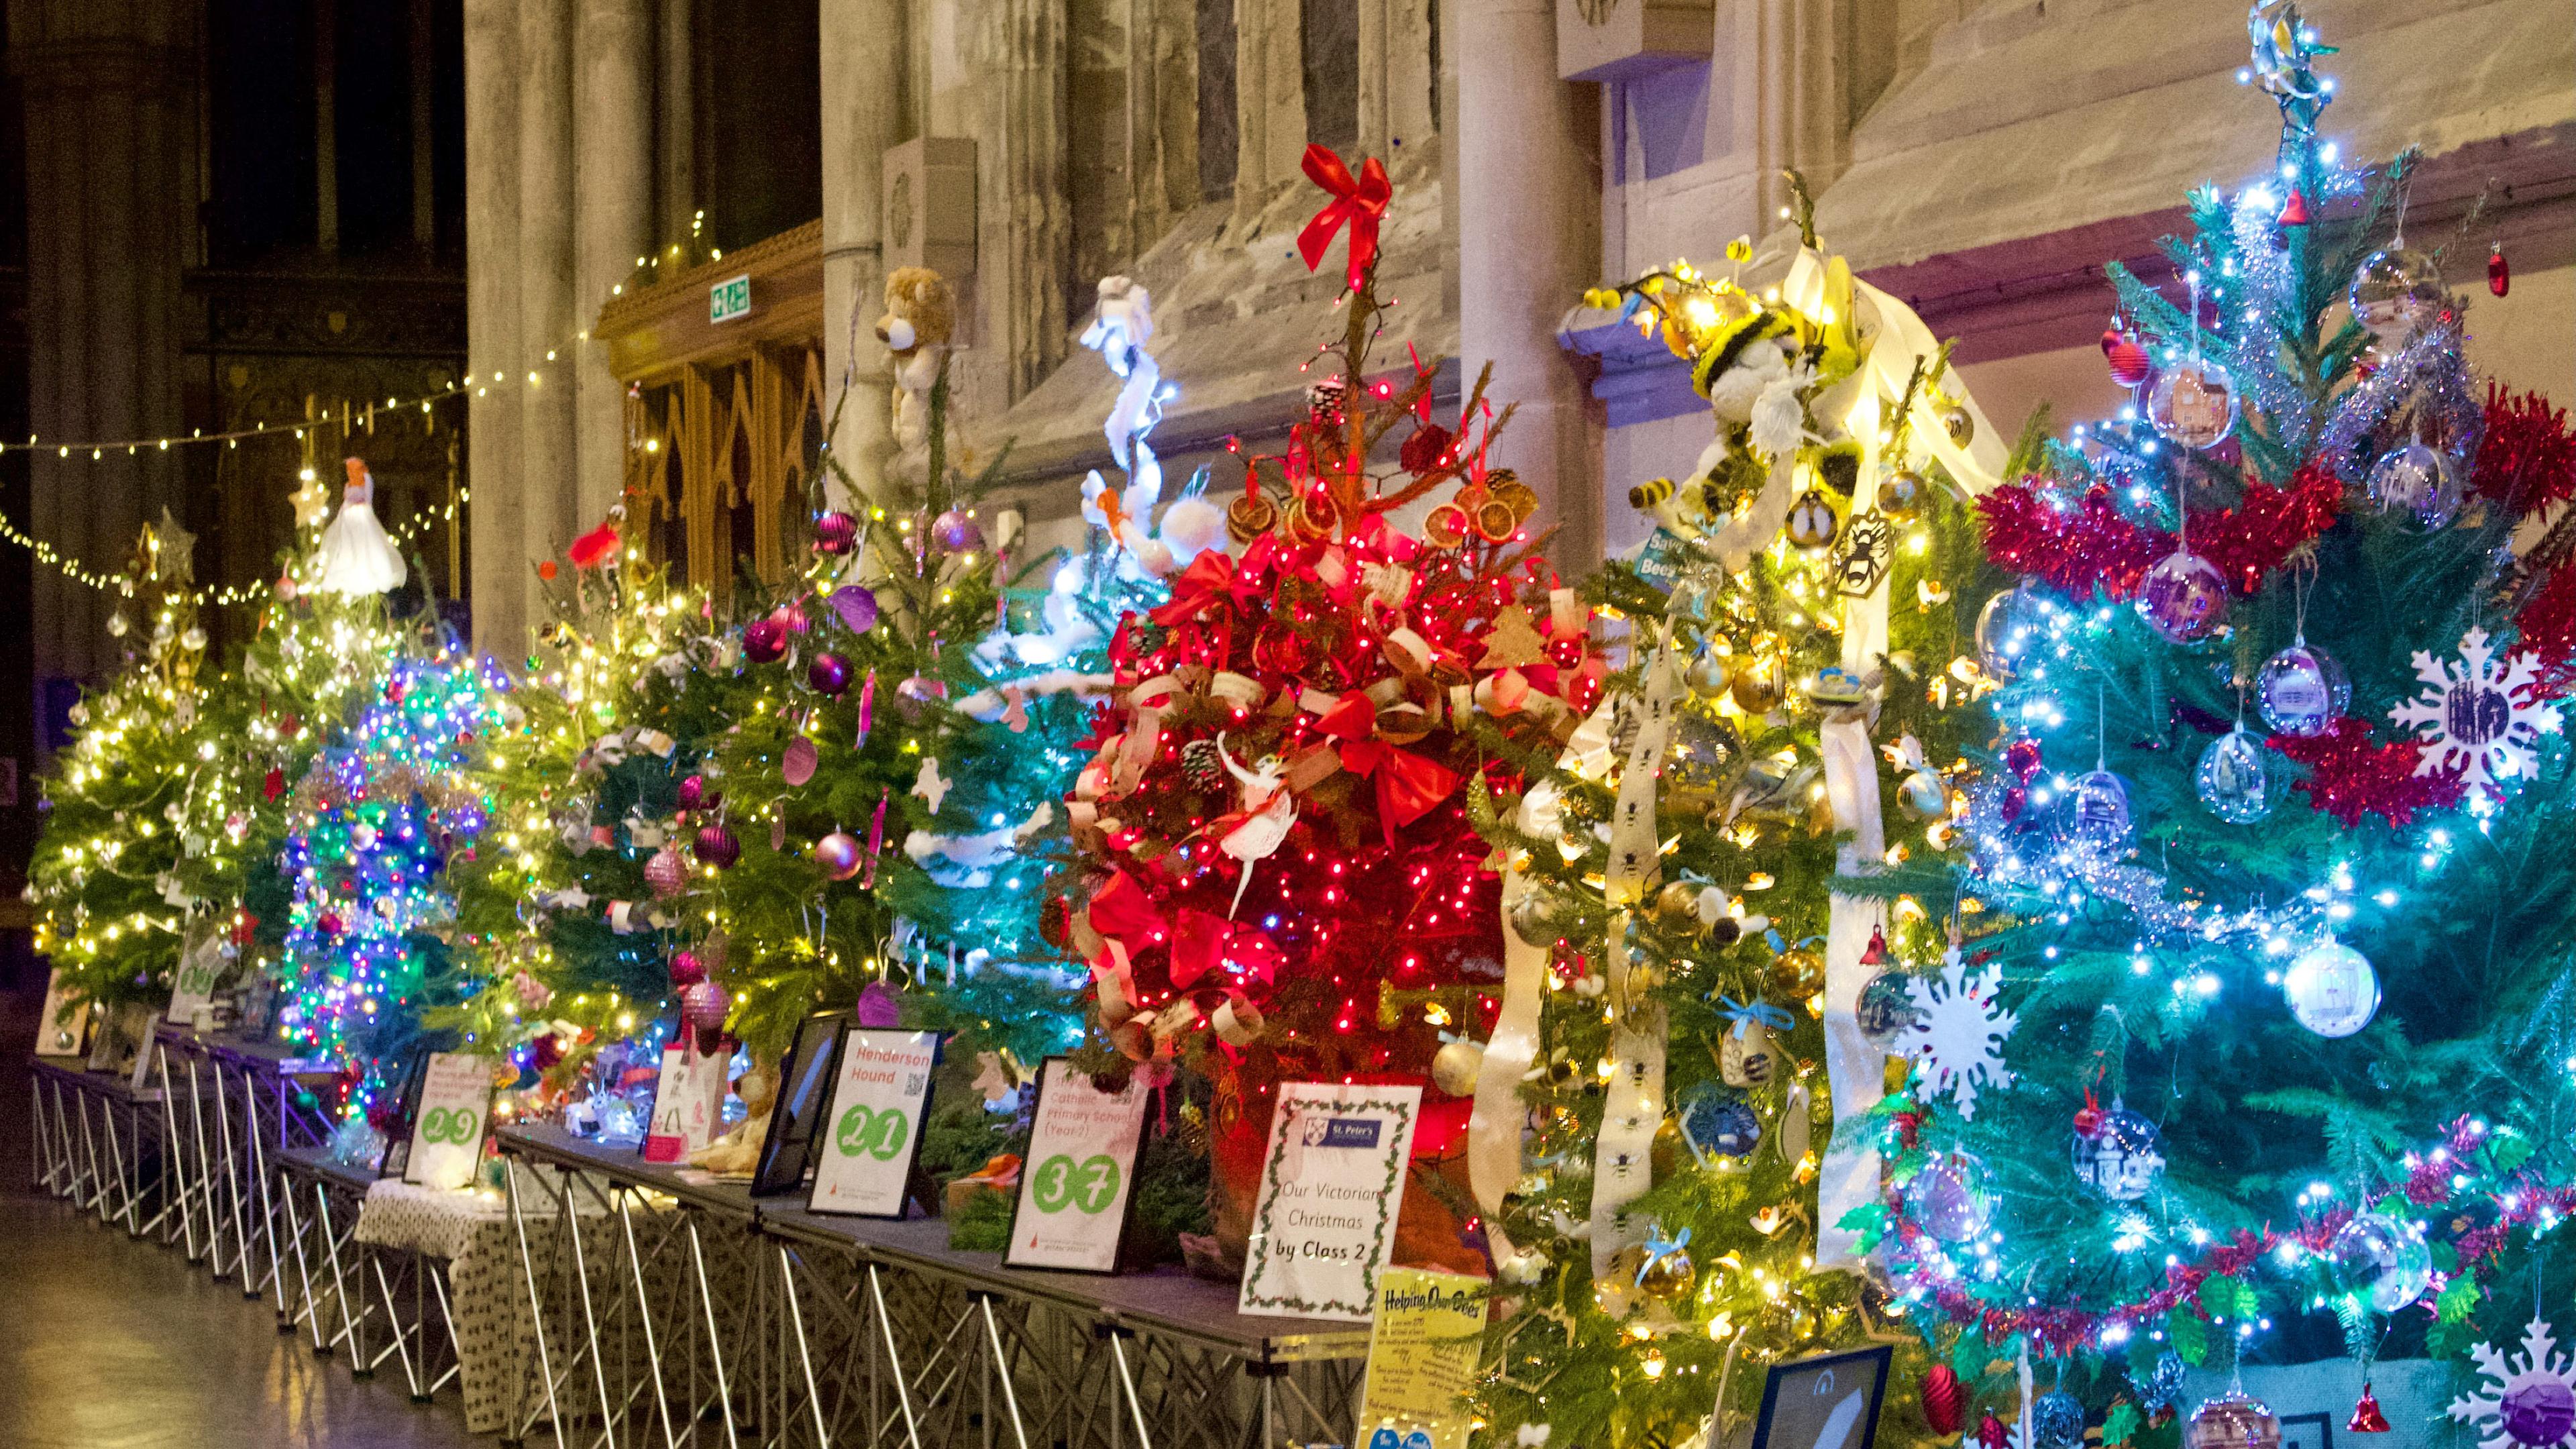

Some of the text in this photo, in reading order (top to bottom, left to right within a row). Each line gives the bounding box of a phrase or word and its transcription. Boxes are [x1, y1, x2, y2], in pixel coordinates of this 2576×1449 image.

[856, 1047, 930, 1069] Henderson
[850, 1067, 896, 1085] Hound
[1051, 1092, 1097, 1106] Catholic
[427, 1111, 472, 1140] 29
[1047, 1108, 1090, 1124] Primary
[841, 1112, 899, 1153] 21
[1044, 1121, 1089, 1137] (Year 2)
[1345, 1124, 1373, 1136] Peter's
[1043, 1163, 1110, 1208] 37
[1282, 1180, 1380, 1201] Our Victorian
[1288, 1208, 1363, 1230] Christmas
[1276, 1239, 1365, 1263] by Class 2
[1385, 1289, 1426, 1315] Helping
